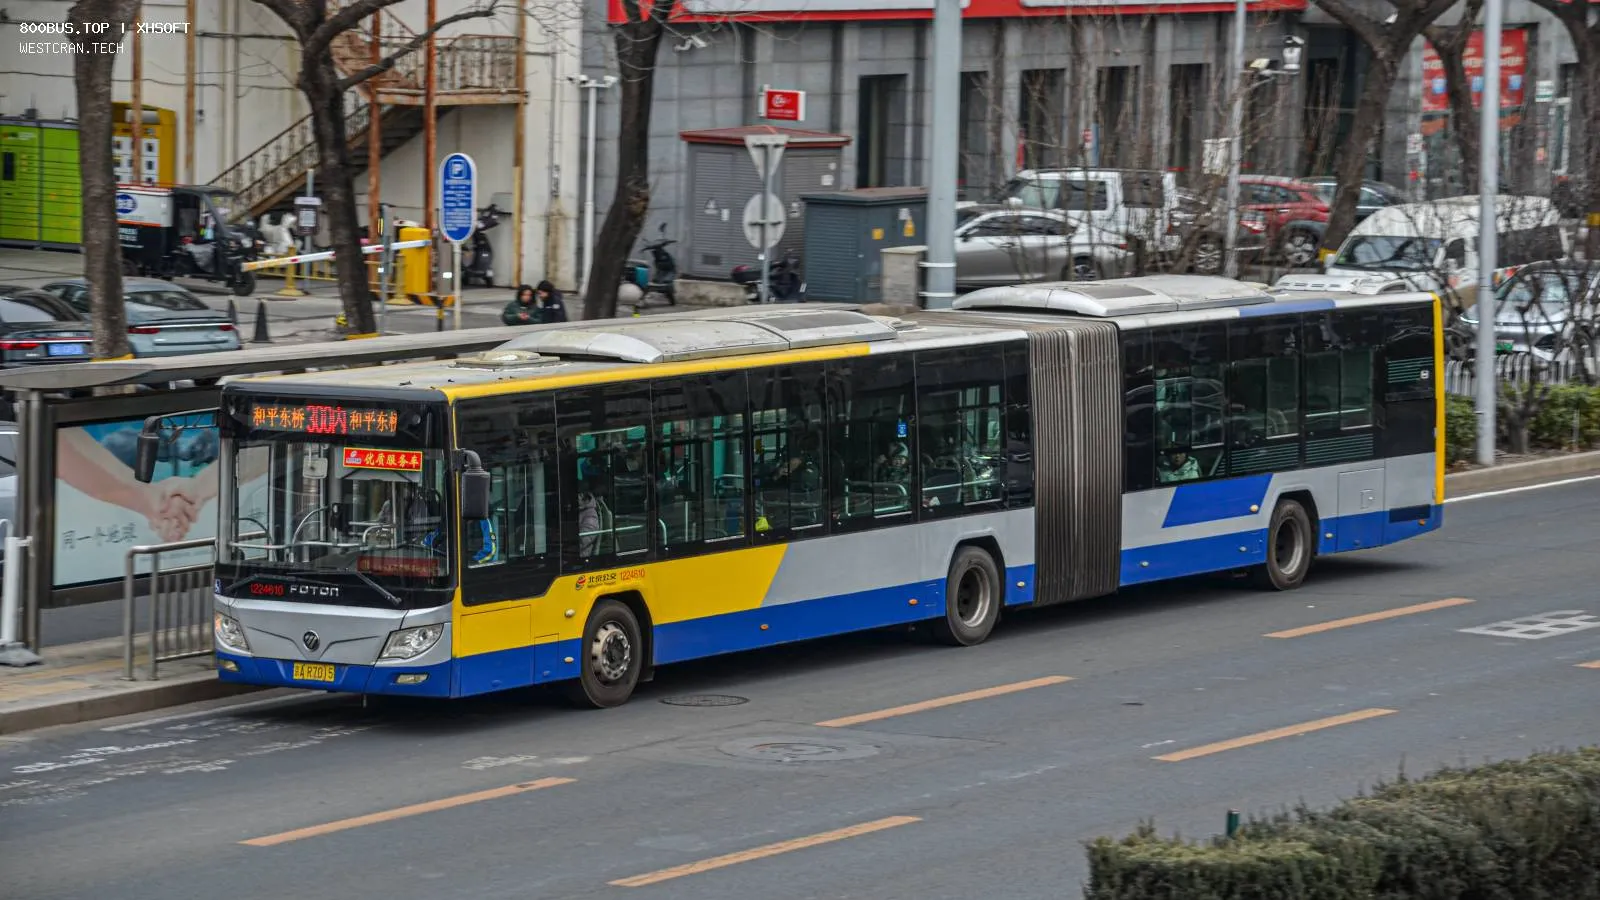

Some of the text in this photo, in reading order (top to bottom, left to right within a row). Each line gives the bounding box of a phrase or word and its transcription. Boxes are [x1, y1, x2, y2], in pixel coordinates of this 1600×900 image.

[252, 407, 305, 429] 和平东桥
[363, 451, 420, 469] 优质服务车
[589, 572, 617, 583] 北京公交
[290, 584, 340, 598] FOTON
